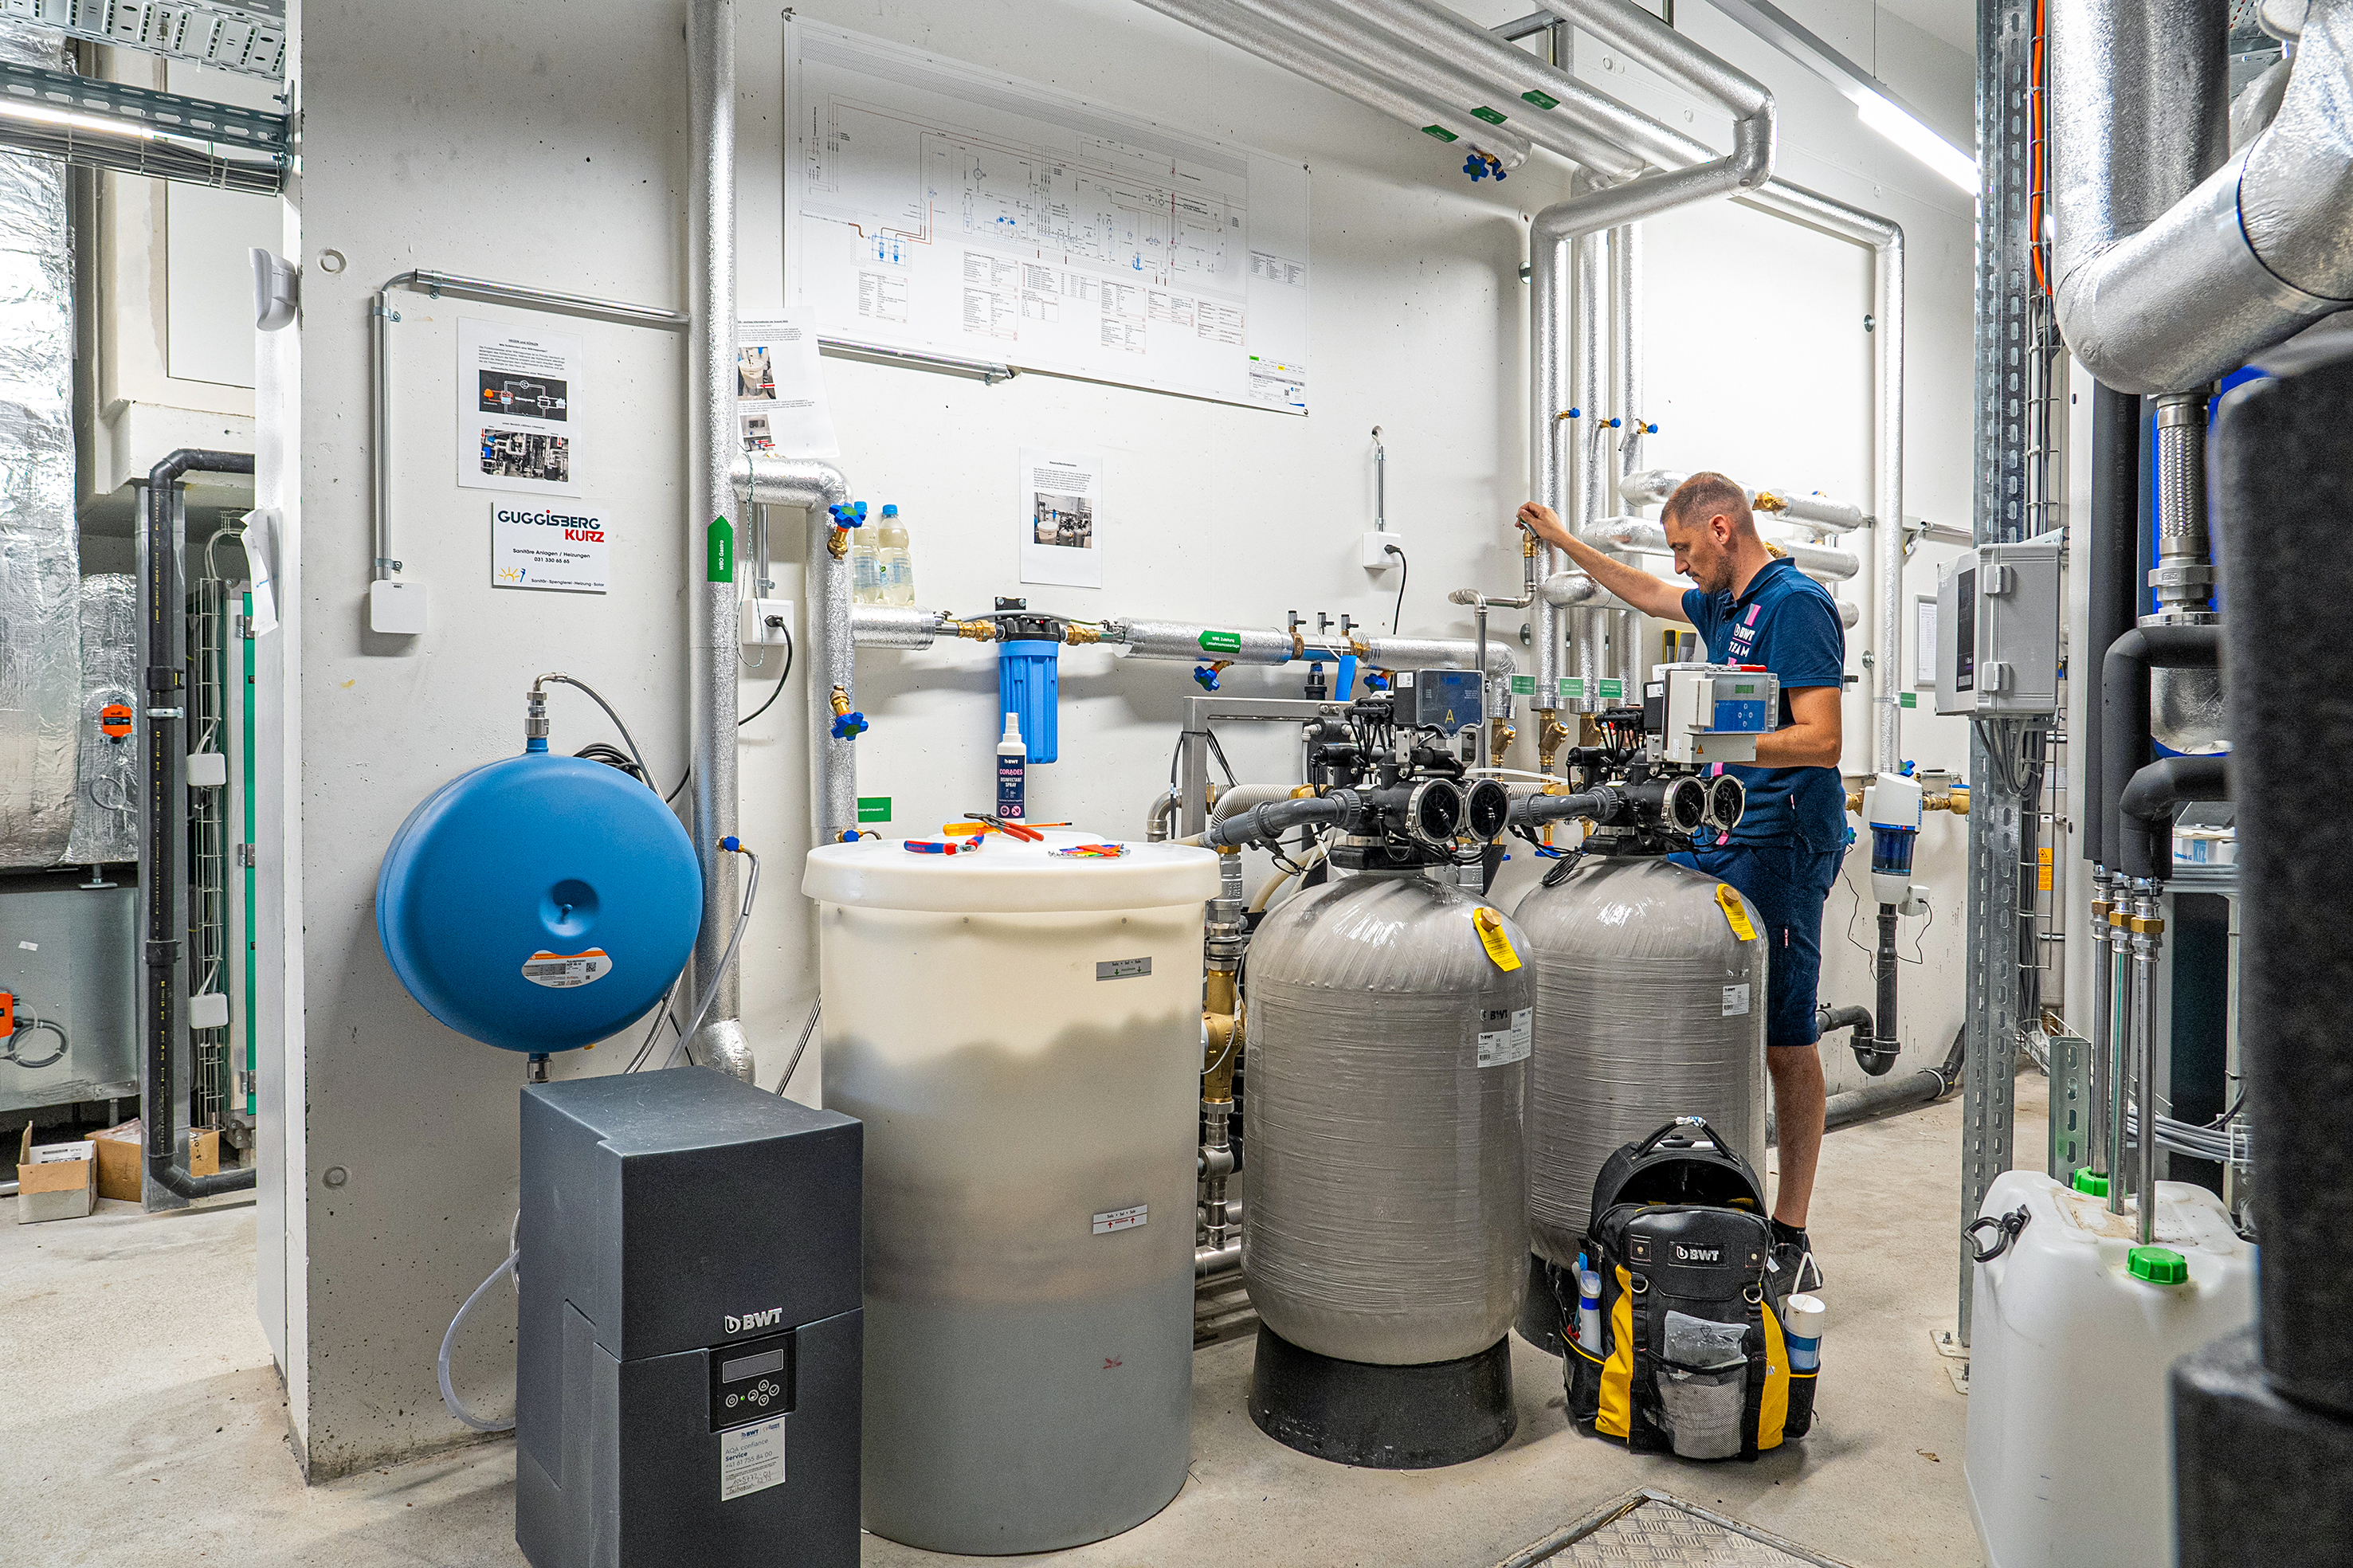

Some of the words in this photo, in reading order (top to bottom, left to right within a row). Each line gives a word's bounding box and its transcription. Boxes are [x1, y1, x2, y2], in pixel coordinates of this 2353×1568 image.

[565, 529, 604, 543] KURZ
[1739, 627, 1755, 641] BWT
[1728, 641, 1751, 657] TEAM
[1445, 709, 1455, 724] A
[1689, 1247, 1720, 1262] BWT
[743, 1307, 782, 1331] BWT
[740, 1439, 768, 1451] confiance
[726, 1452, 747, 1462] Service
